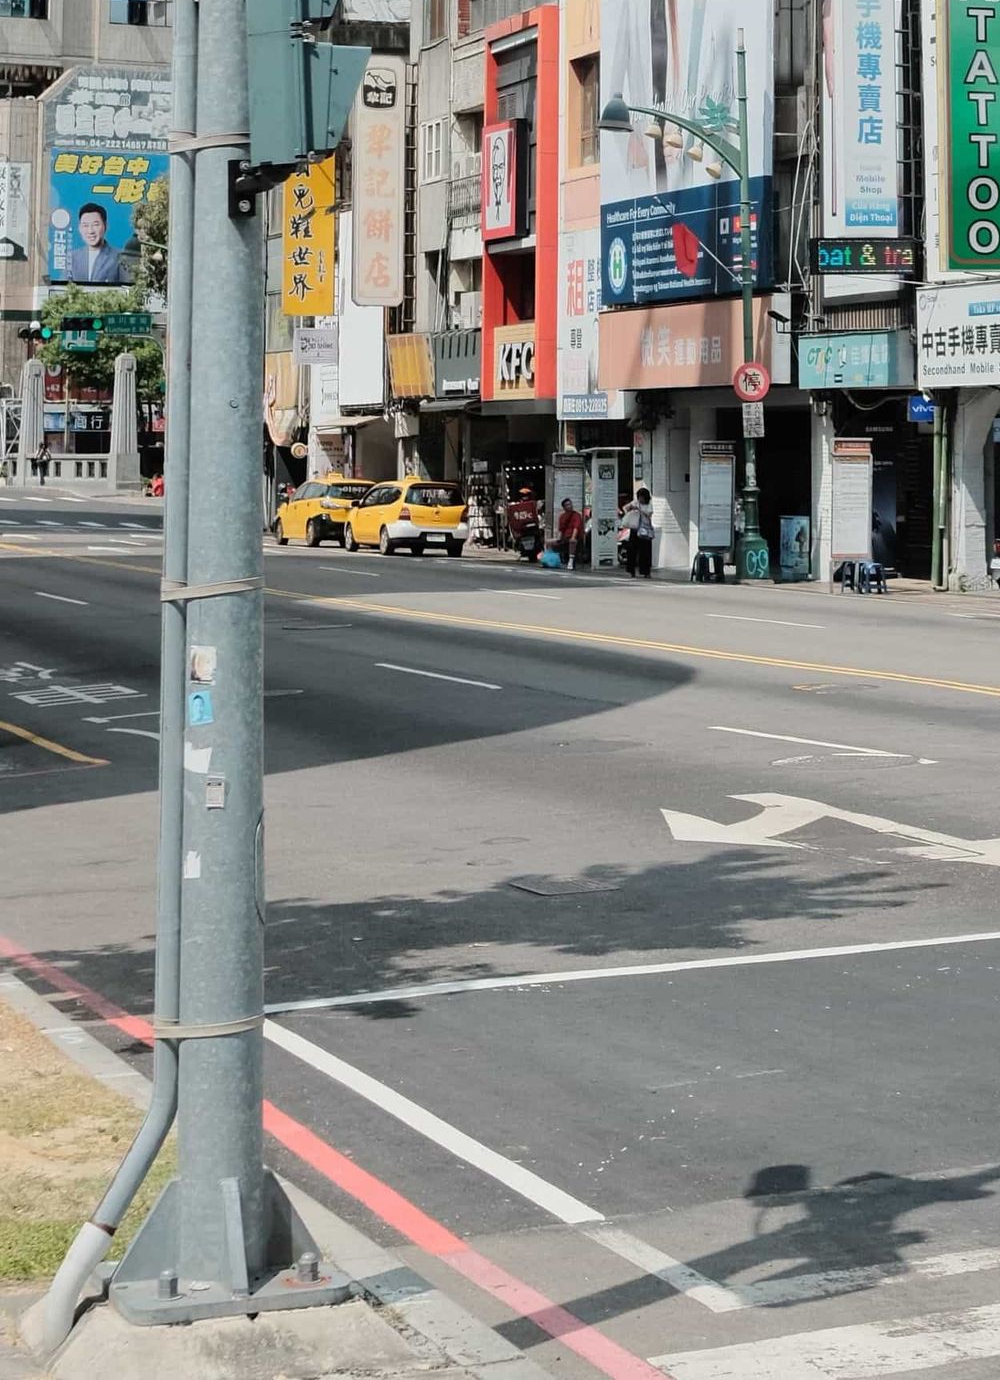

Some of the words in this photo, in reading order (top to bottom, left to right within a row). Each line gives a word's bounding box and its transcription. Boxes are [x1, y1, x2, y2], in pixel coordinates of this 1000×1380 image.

[962, 6, 1000, 256] TATTOO
[54, 154, 150, 177] 美好台中
[567, 259, 585, 316] 租
[498, 341, 535, 383] KFC
[922, 362, 966, 376] Secondhand
[969, 360, 995, 374] Mobile
[743, 372, 761, 392] 停
